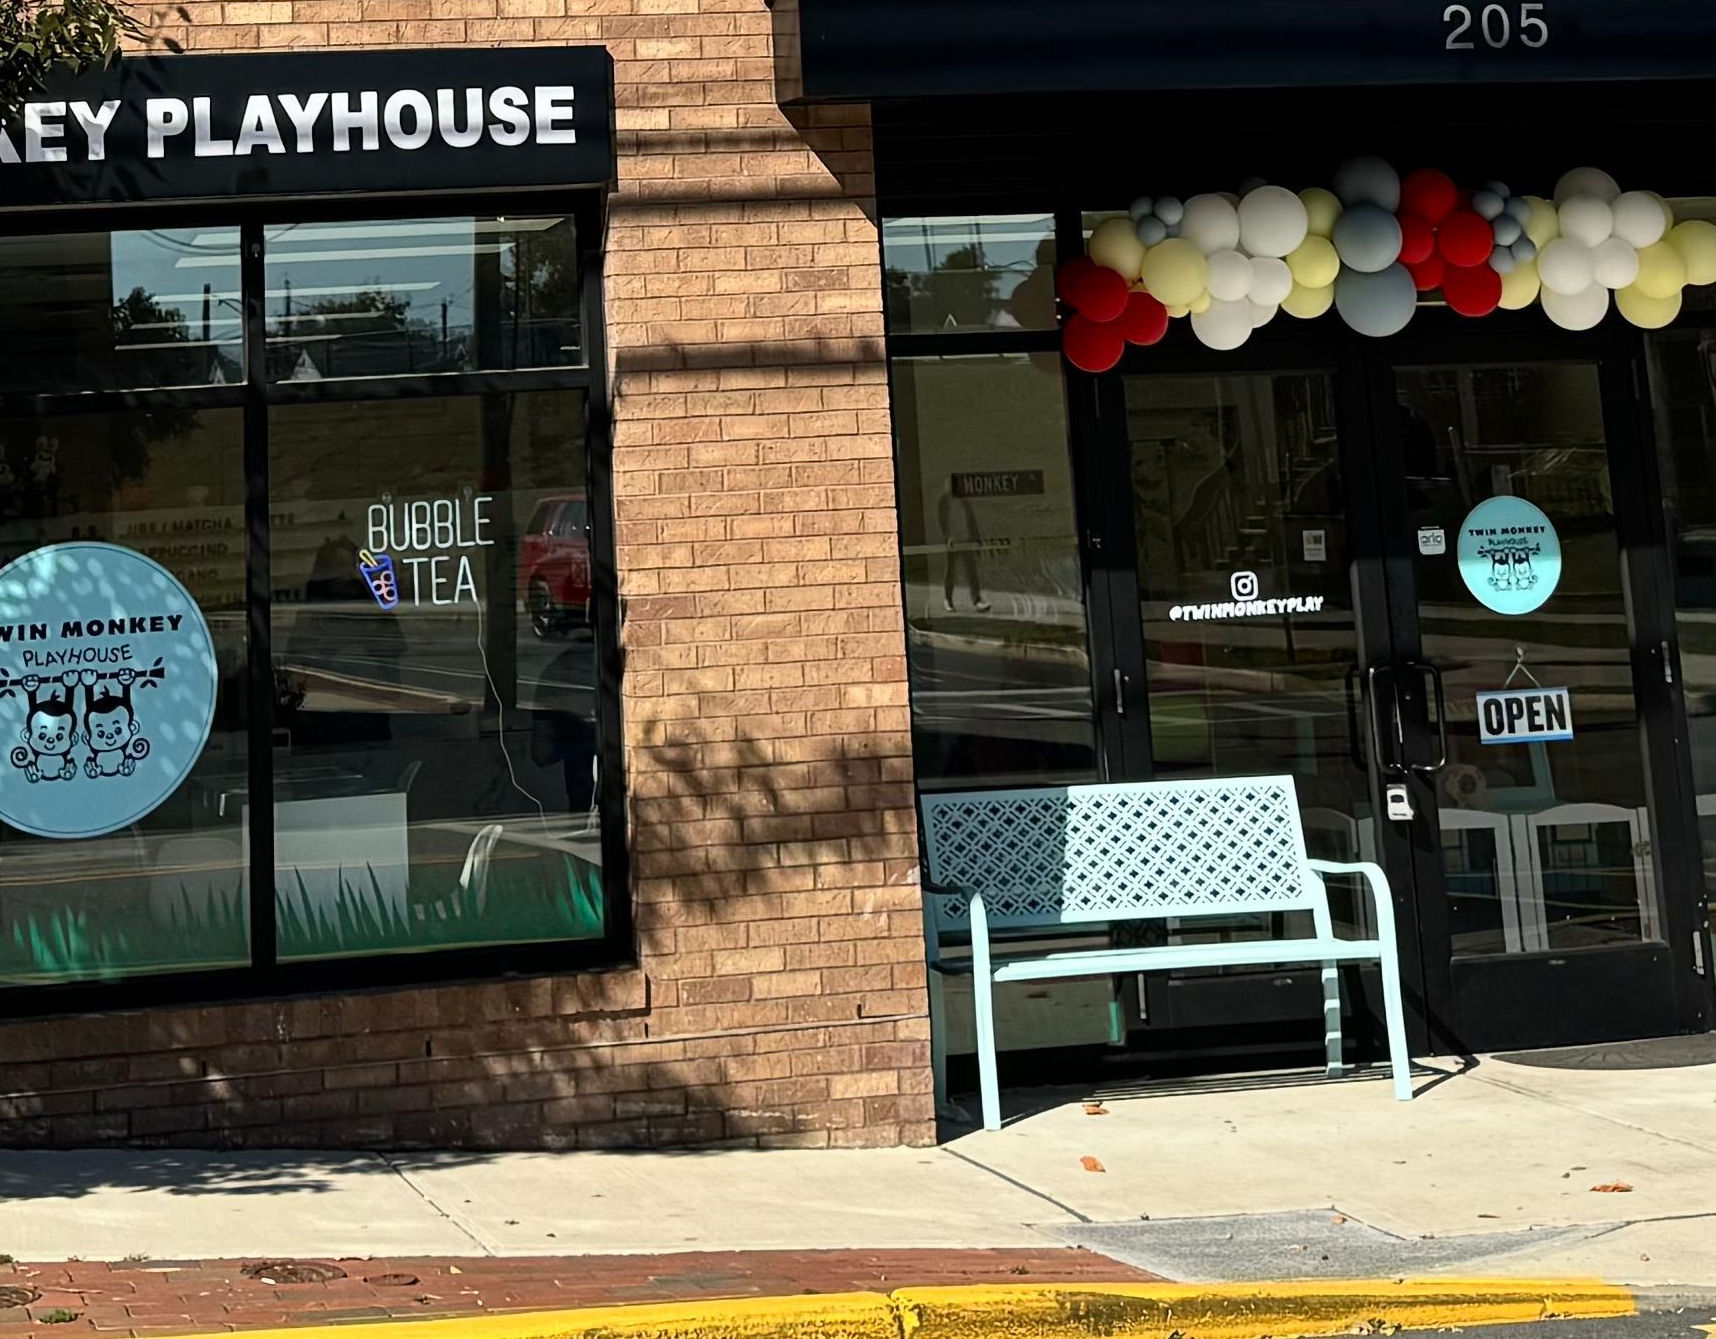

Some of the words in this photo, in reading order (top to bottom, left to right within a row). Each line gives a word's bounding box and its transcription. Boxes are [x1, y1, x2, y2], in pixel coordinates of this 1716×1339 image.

[1443, 3, 1549, 50] 205
[146, 85, 577, 159] PLAYHOUSE
[963, 475, 1020, 494] MONKEY
[367, 496, 495, 553] BUBBLE
[1468, 528, 1497, 537] TWIN
[1501, 525, 1546, 535] MONKEY
[402, 555, 477, 607] TEA
[1169, 596, 1324, 622] @TWINMONKEYPLAY
[61, 614, 184, 639] MONKEY
[22, 643, 133, 668] PLAYHOUSE
[1483, 694, 1568, 736] OPEN
